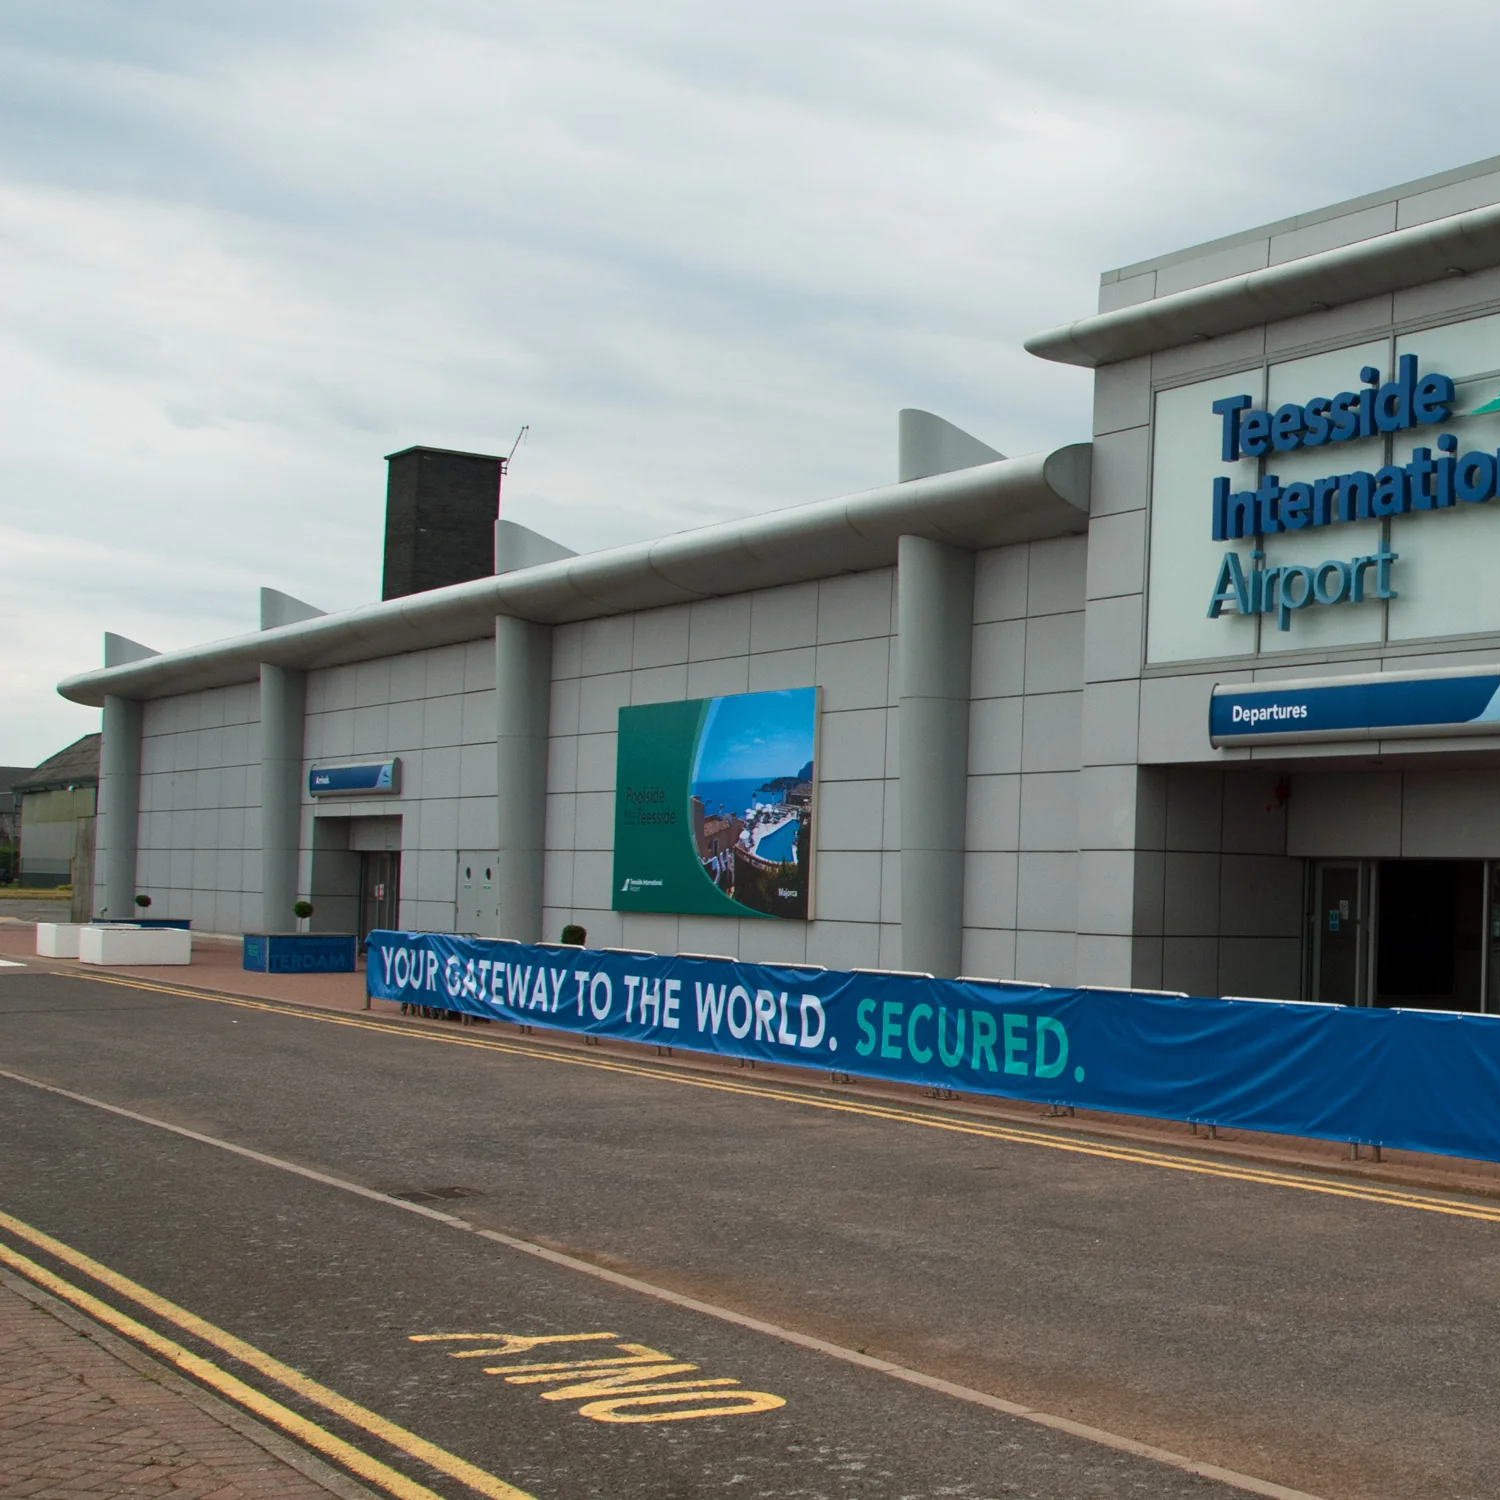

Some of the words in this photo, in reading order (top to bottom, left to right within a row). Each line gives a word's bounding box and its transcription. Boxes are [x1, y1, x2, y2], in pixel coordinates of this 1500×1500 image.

[1212, 353, 1455, 463] Teesside
[1206, 540, 1399, 631] Airport
[1232, 703, 1308, 725] Departures
[625, 786, 665, 804] Poolside
[637, 806, 676, 825] Teesside
[778, 888, 798, 899] Majorca
[381, 946, 438, 991] YOUR
[445, 955, 568, 1013] GATEWAY
[575, 971, 612, 1020] TO
[624, 975, 682, 1030] THE
[695, 981, 838, 1052] WORLD.
[855, 998, 1085, 1083] SECURED.
[408, 1331, 787, 1424] ONLY
